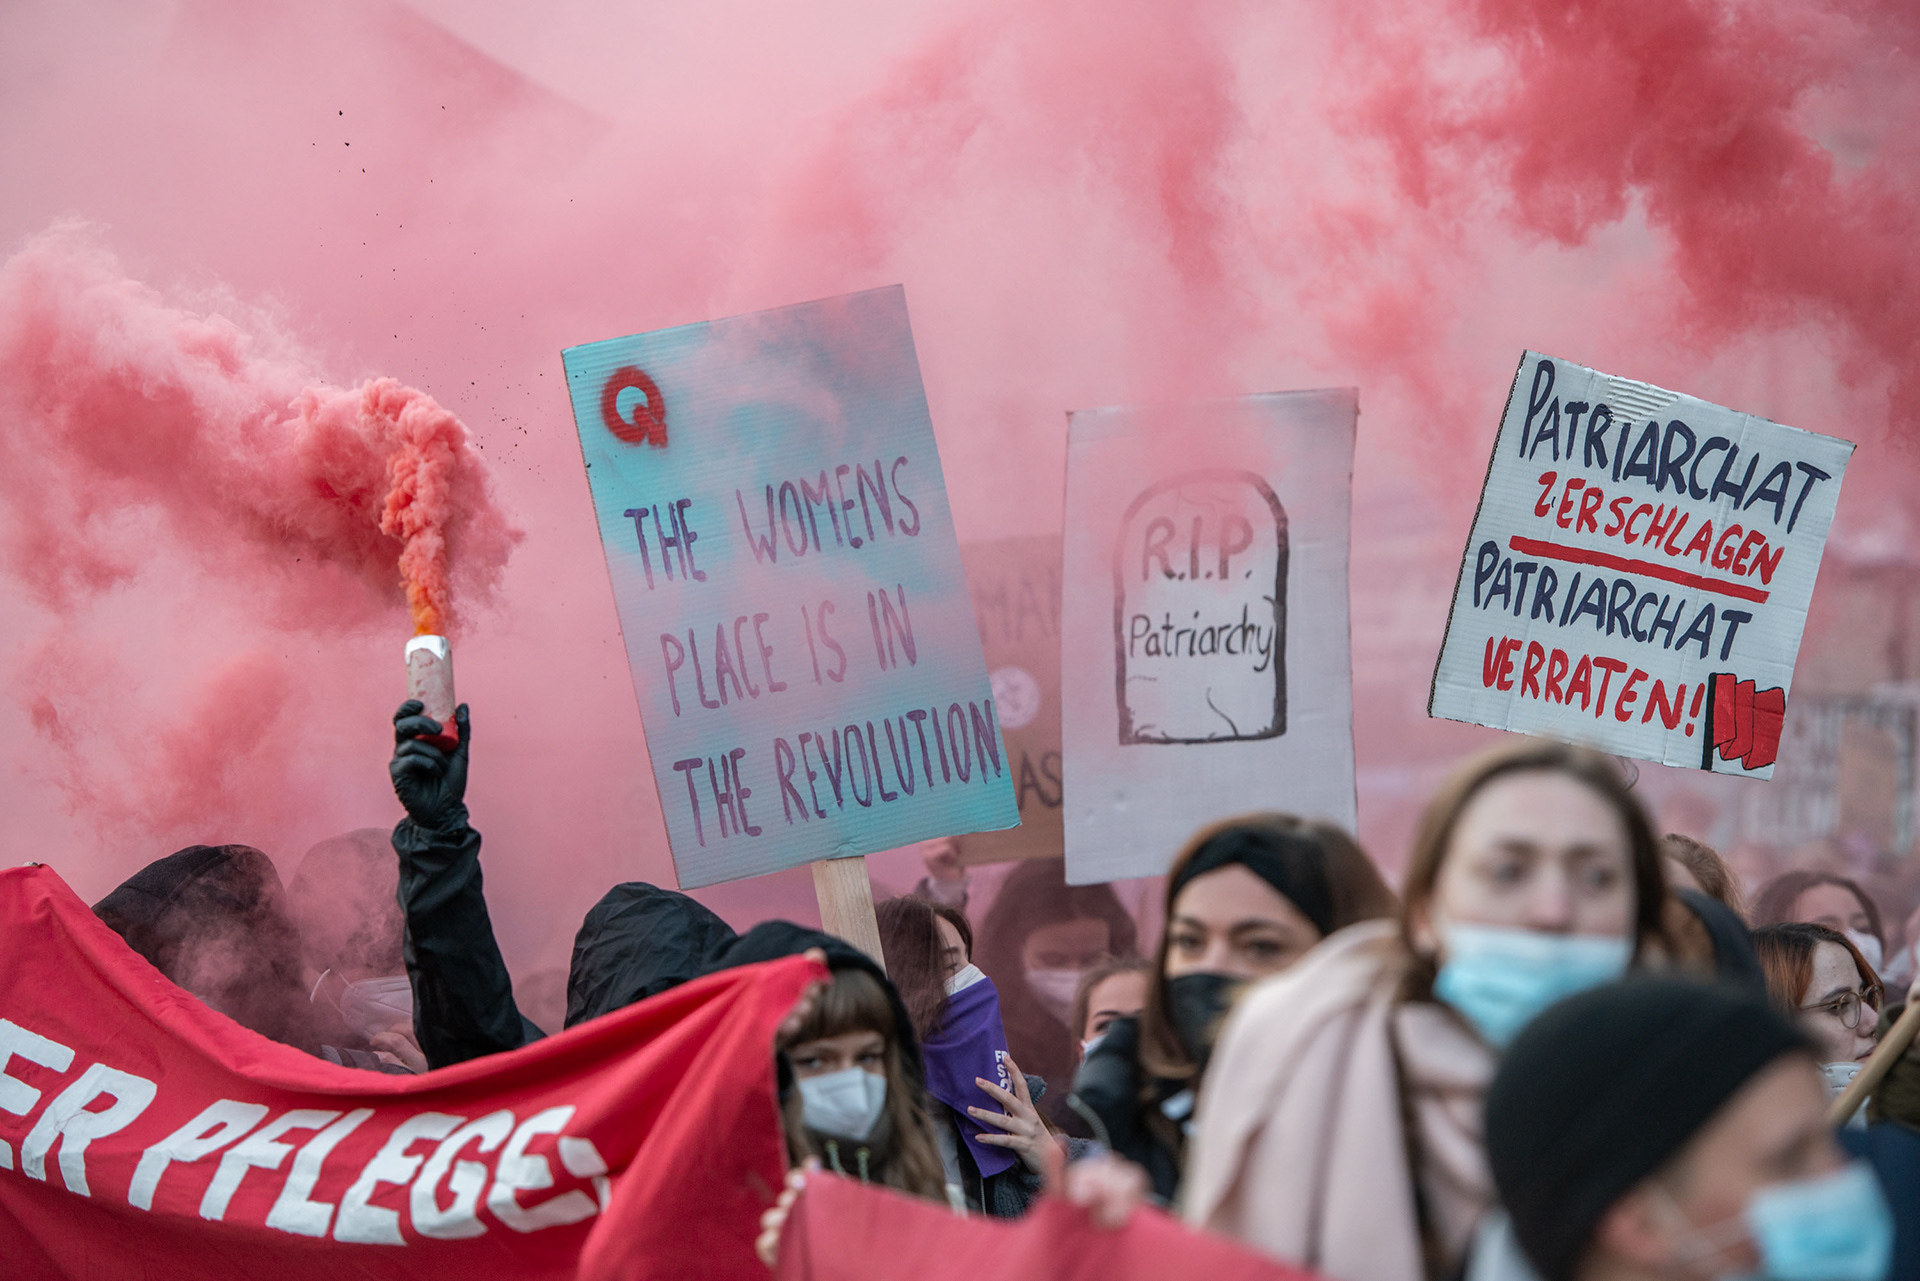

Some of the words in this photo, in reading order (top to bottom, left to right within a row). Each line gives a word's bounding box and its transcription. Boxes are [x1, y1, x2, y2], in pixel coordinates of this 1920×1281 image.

[1519, 360, 1832, 534] PATRIARCHAT
[623, 498, 708, 591] THE
[736, 456, 921, 565] WOMENS
[1142, 514, 1254, 581] R.I.P.
[660, 612, 788, 718] PLACE
[801, 600, 848, 685] IS
[867, 583, 918, 671] IN
[1130, 602, 1273, 673] Patriarchy
[1474, 540, 1753, 662] PATRIARCHAT
[1482, 635, 1706, 738] VERRATEN!
[673, 747, 763, 847] THE
[773, 699, 1002, 825] REVOLUTION
